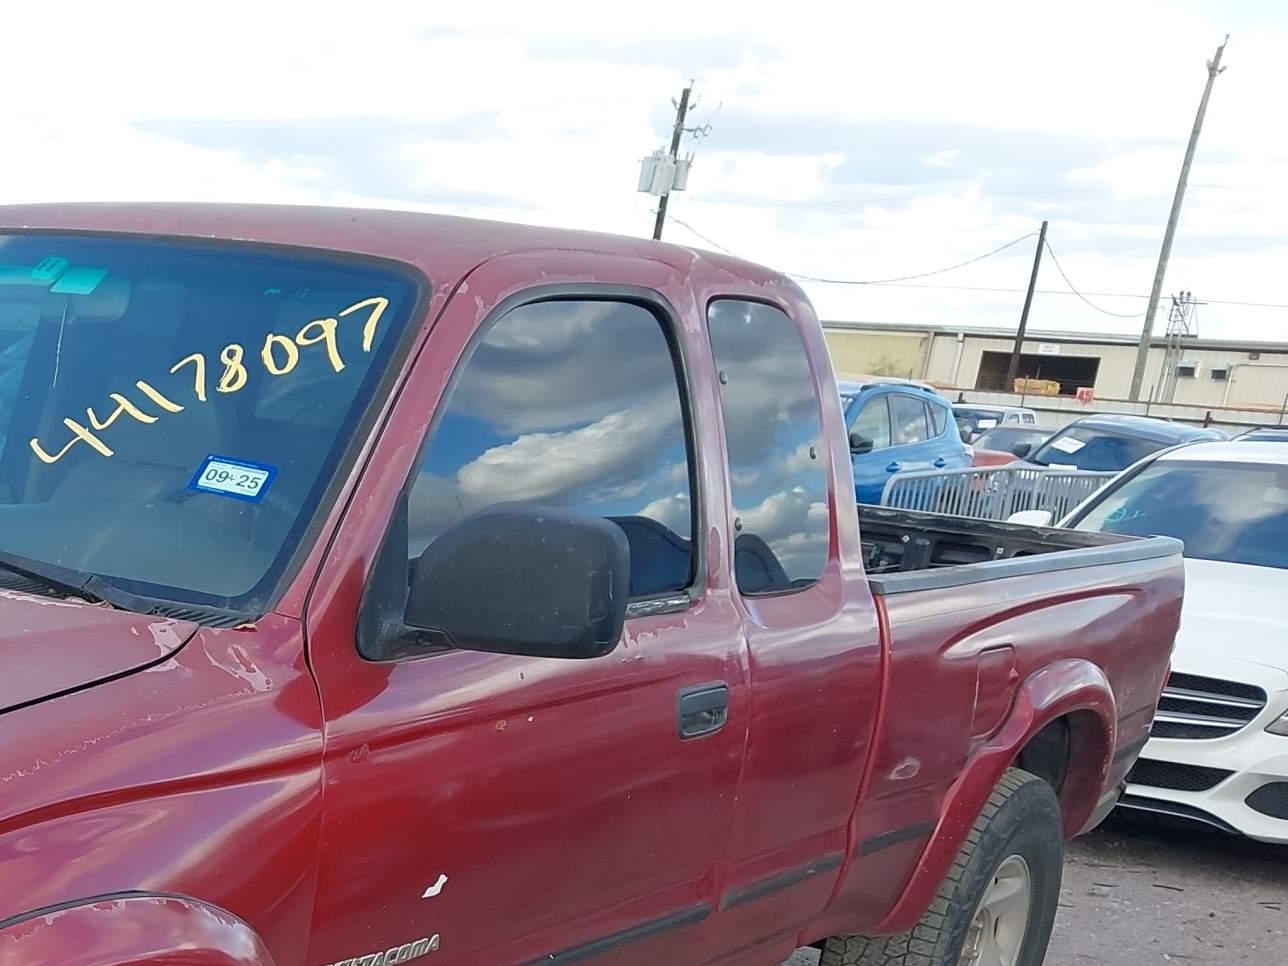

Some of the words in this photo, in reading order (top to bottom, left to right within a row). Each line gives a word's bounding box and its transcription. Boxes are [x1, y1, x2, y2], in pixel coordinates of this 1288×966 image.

[29, 296, 389, 464] 44178097
[205, 468, 230, 483] 09
[235, 474, 262, 490] 25
